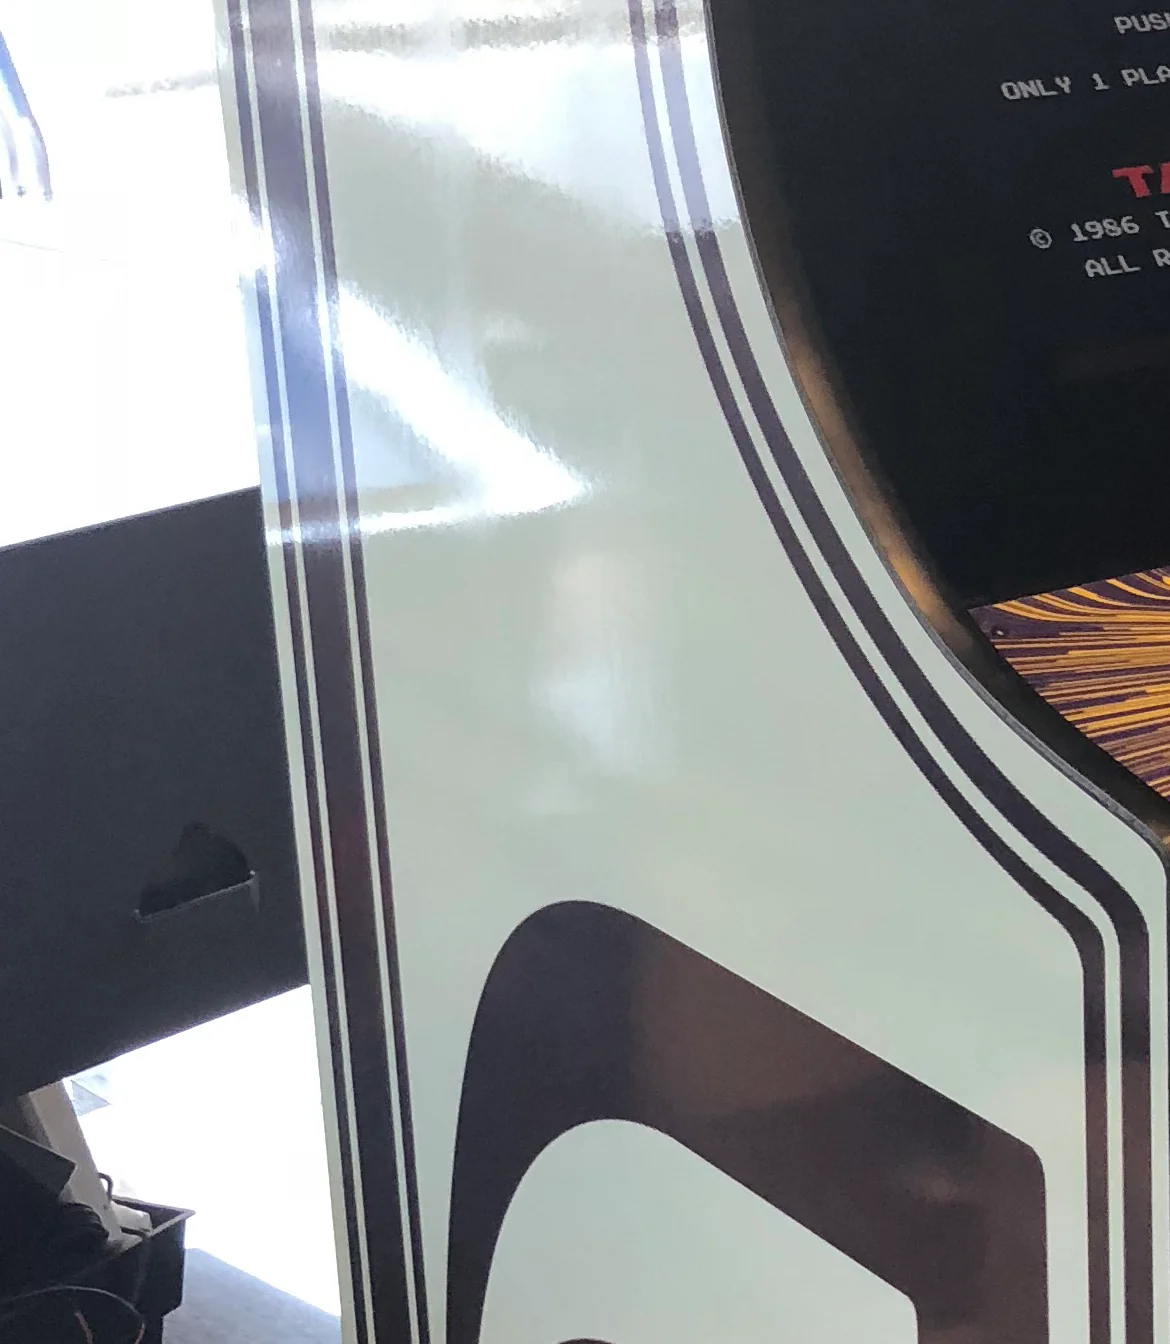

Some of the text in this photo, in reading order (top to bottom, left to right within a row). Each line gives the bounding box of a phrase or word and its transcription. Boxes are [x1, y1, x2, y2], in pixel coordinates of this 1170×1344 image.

[1001, 76, 1072, 100] ONLY
[1092, 73, 1110, 91] 1
[1071, 216, 1141, 242] 1986
[1084, 255, 1141, 278] ALL
